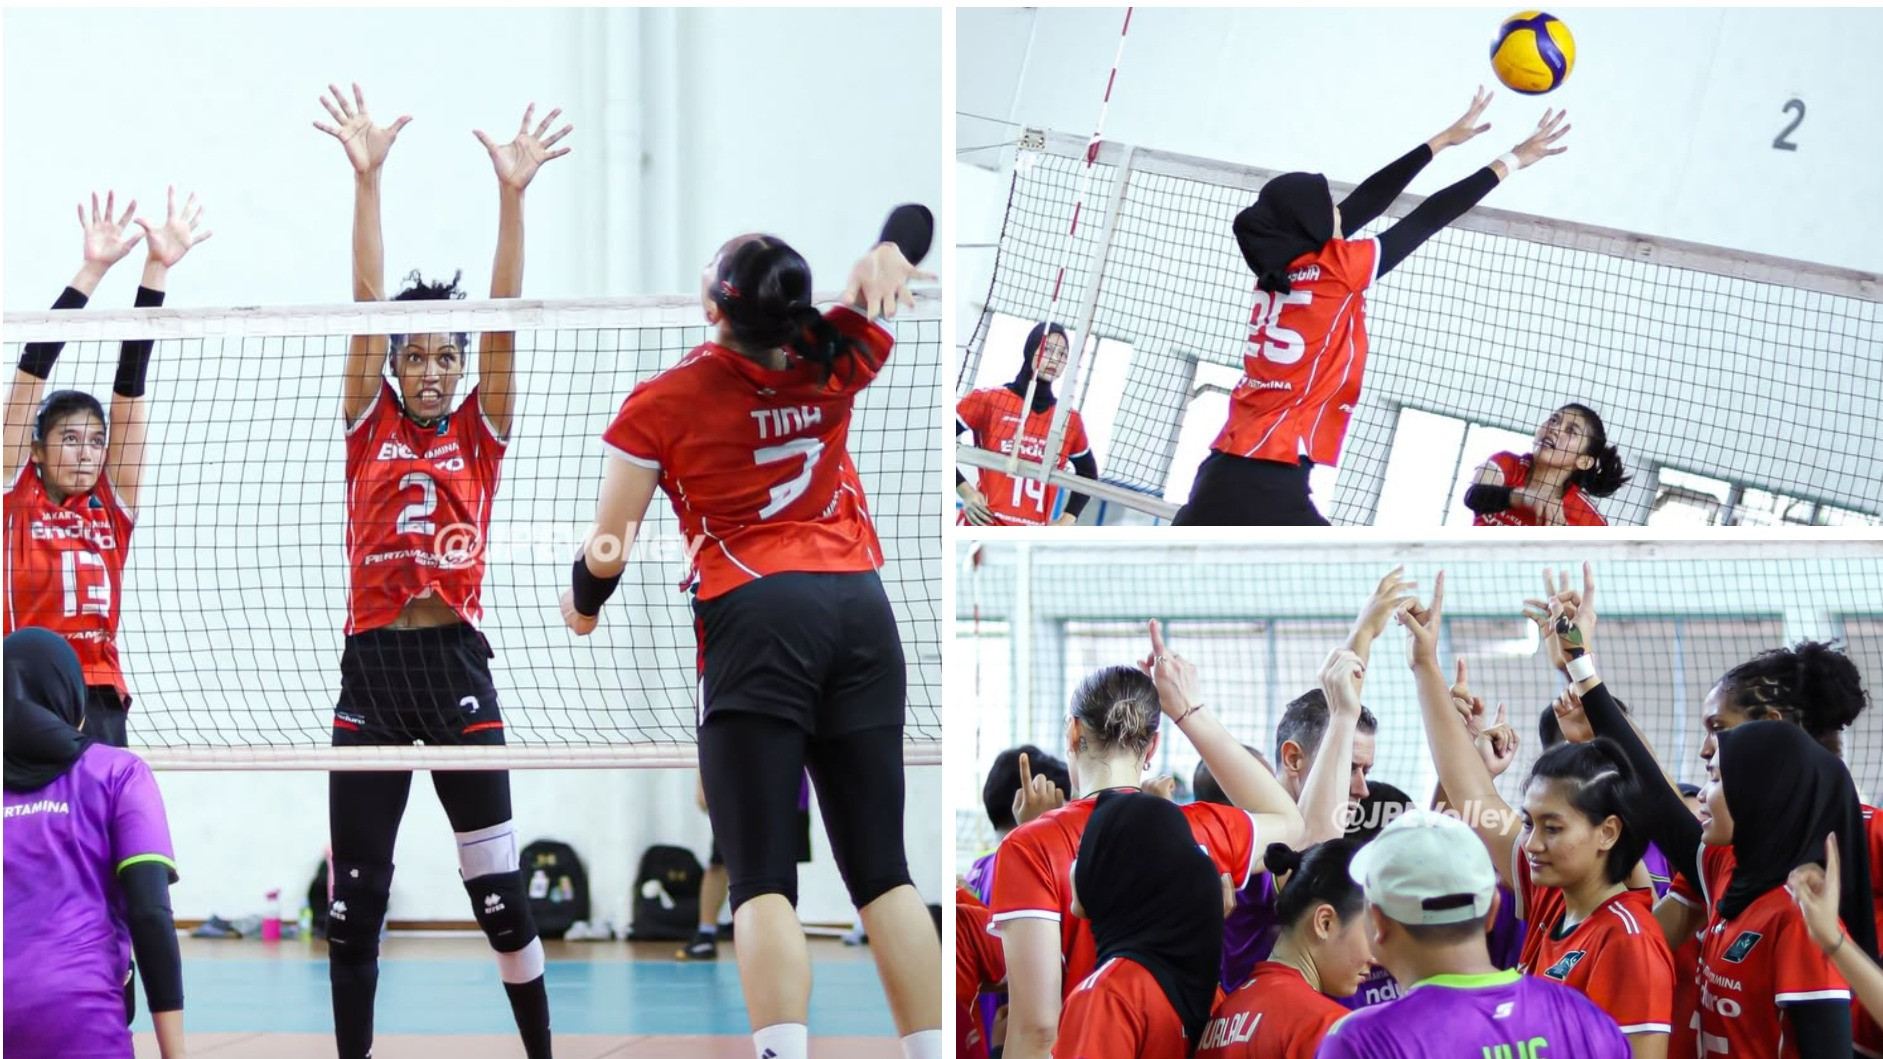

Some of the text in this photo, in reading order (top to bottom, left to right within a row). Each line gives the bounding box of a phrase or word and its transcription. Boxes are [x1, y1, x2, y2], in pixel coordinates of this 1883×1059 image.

[1772, 98, 1806, 151] 2
[1243, 290, 1313, 365] 25
[396, 471, 437, 535] 2
[1006, 472, 1046, 513] 14
[61, 550, 111, 618] 13
[3, 800, 69, 818] RTAMINA
